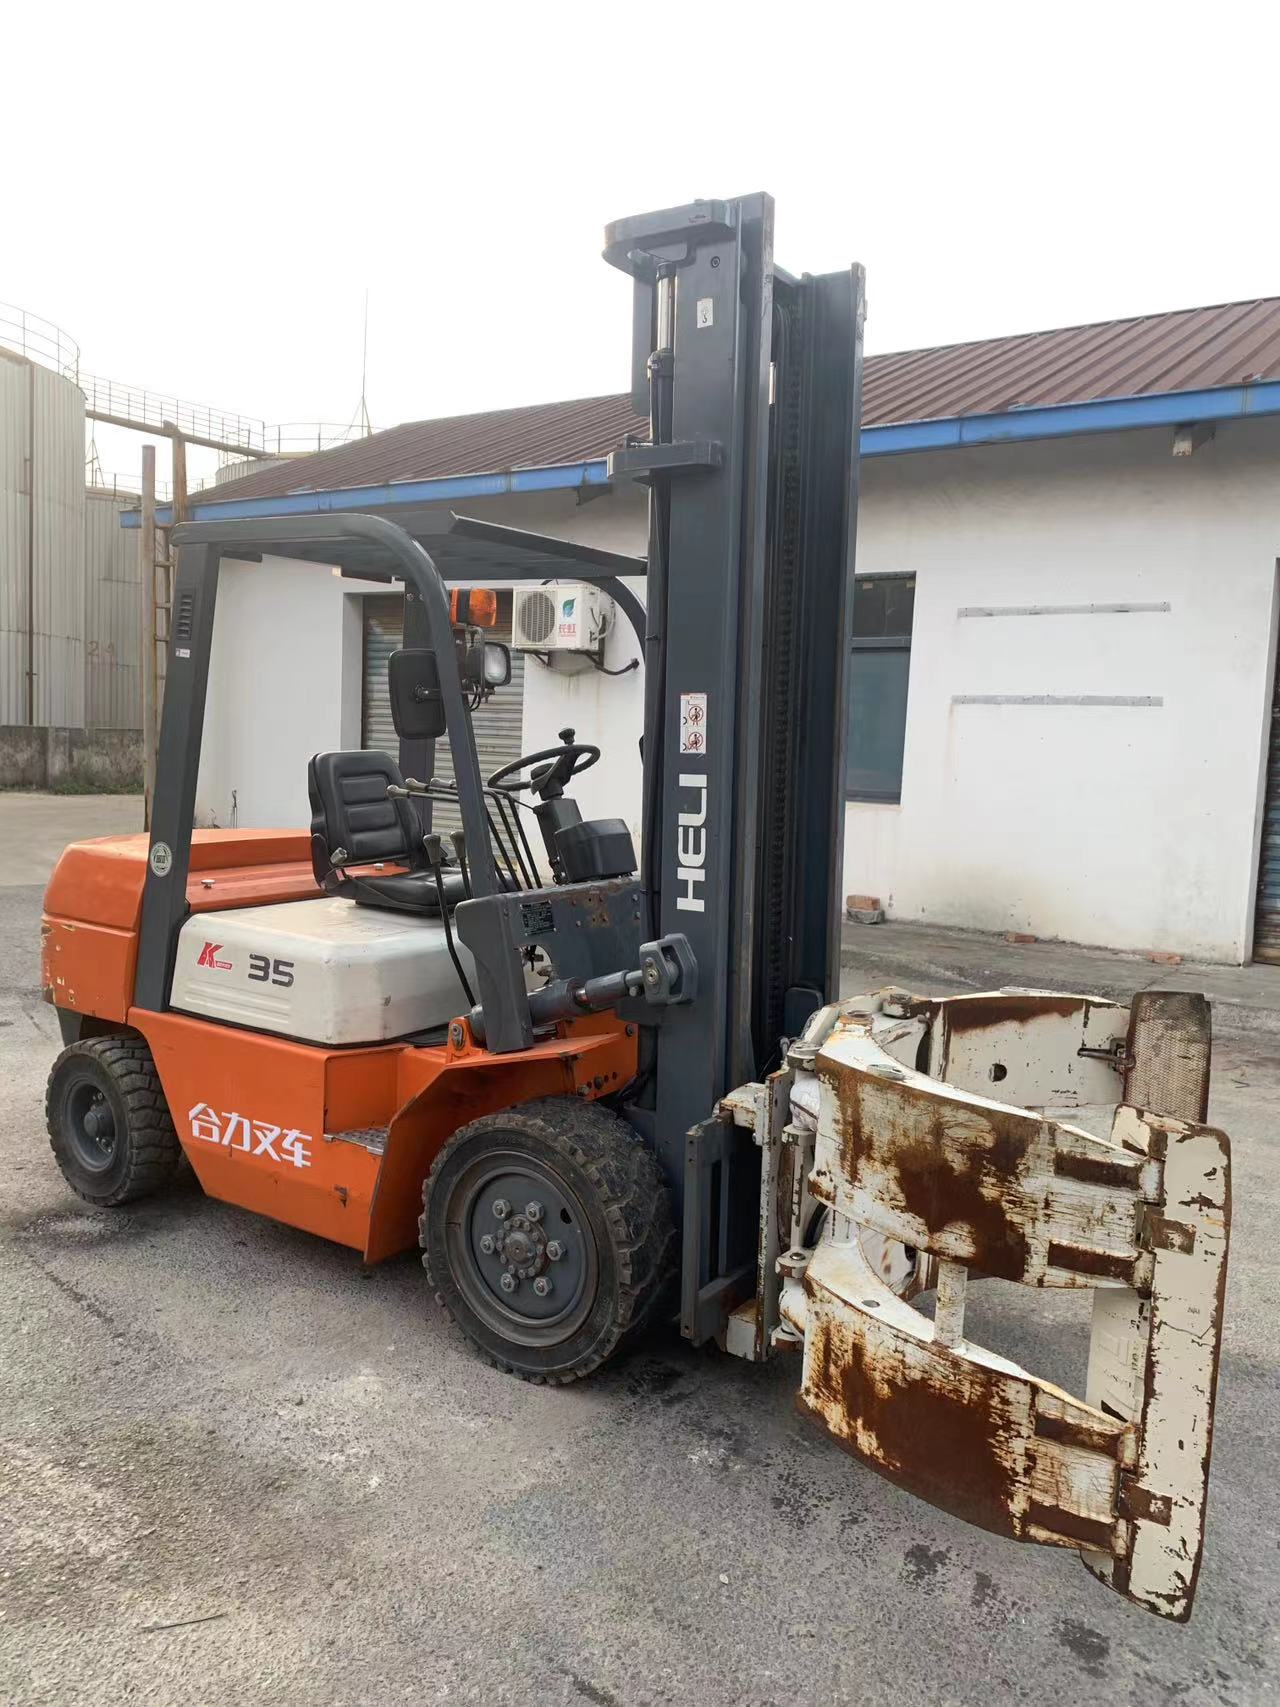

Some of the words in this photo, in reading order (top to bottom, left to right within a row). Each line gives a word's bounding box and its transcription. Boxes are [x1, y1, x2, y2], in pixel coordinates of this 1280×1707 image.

[676, 773, 707, 912] HELI
[247, 953, 295, 988] 35
[188, 1102, 313, 1168] 合力叉车
